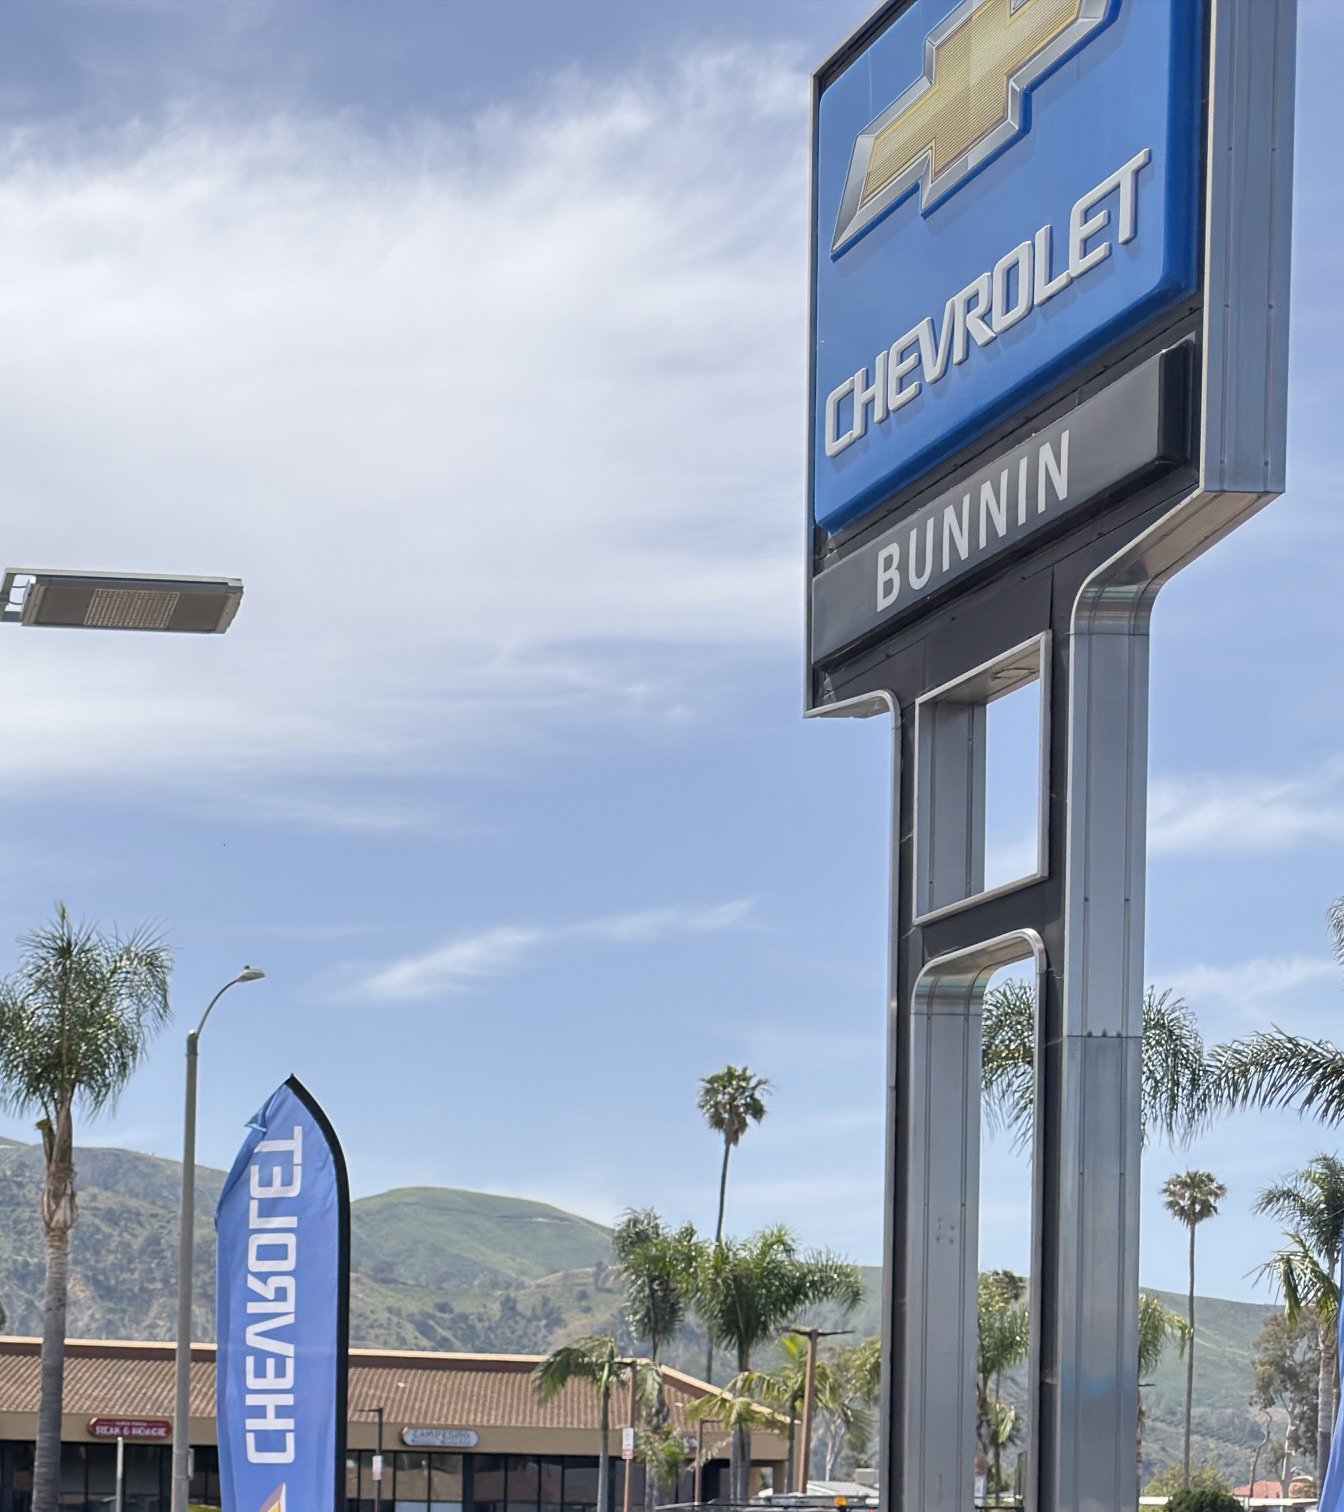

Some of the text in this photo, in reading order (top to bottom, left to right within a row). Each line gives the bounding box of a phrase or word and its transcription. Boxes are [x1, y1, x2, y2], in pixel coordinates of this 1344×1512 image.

[825, 147, 1152, 457] CHEVROLET
[876, 429, 1070, 612] BUNNIN
[245, 1126, 303, 1464] CHEVROLET
